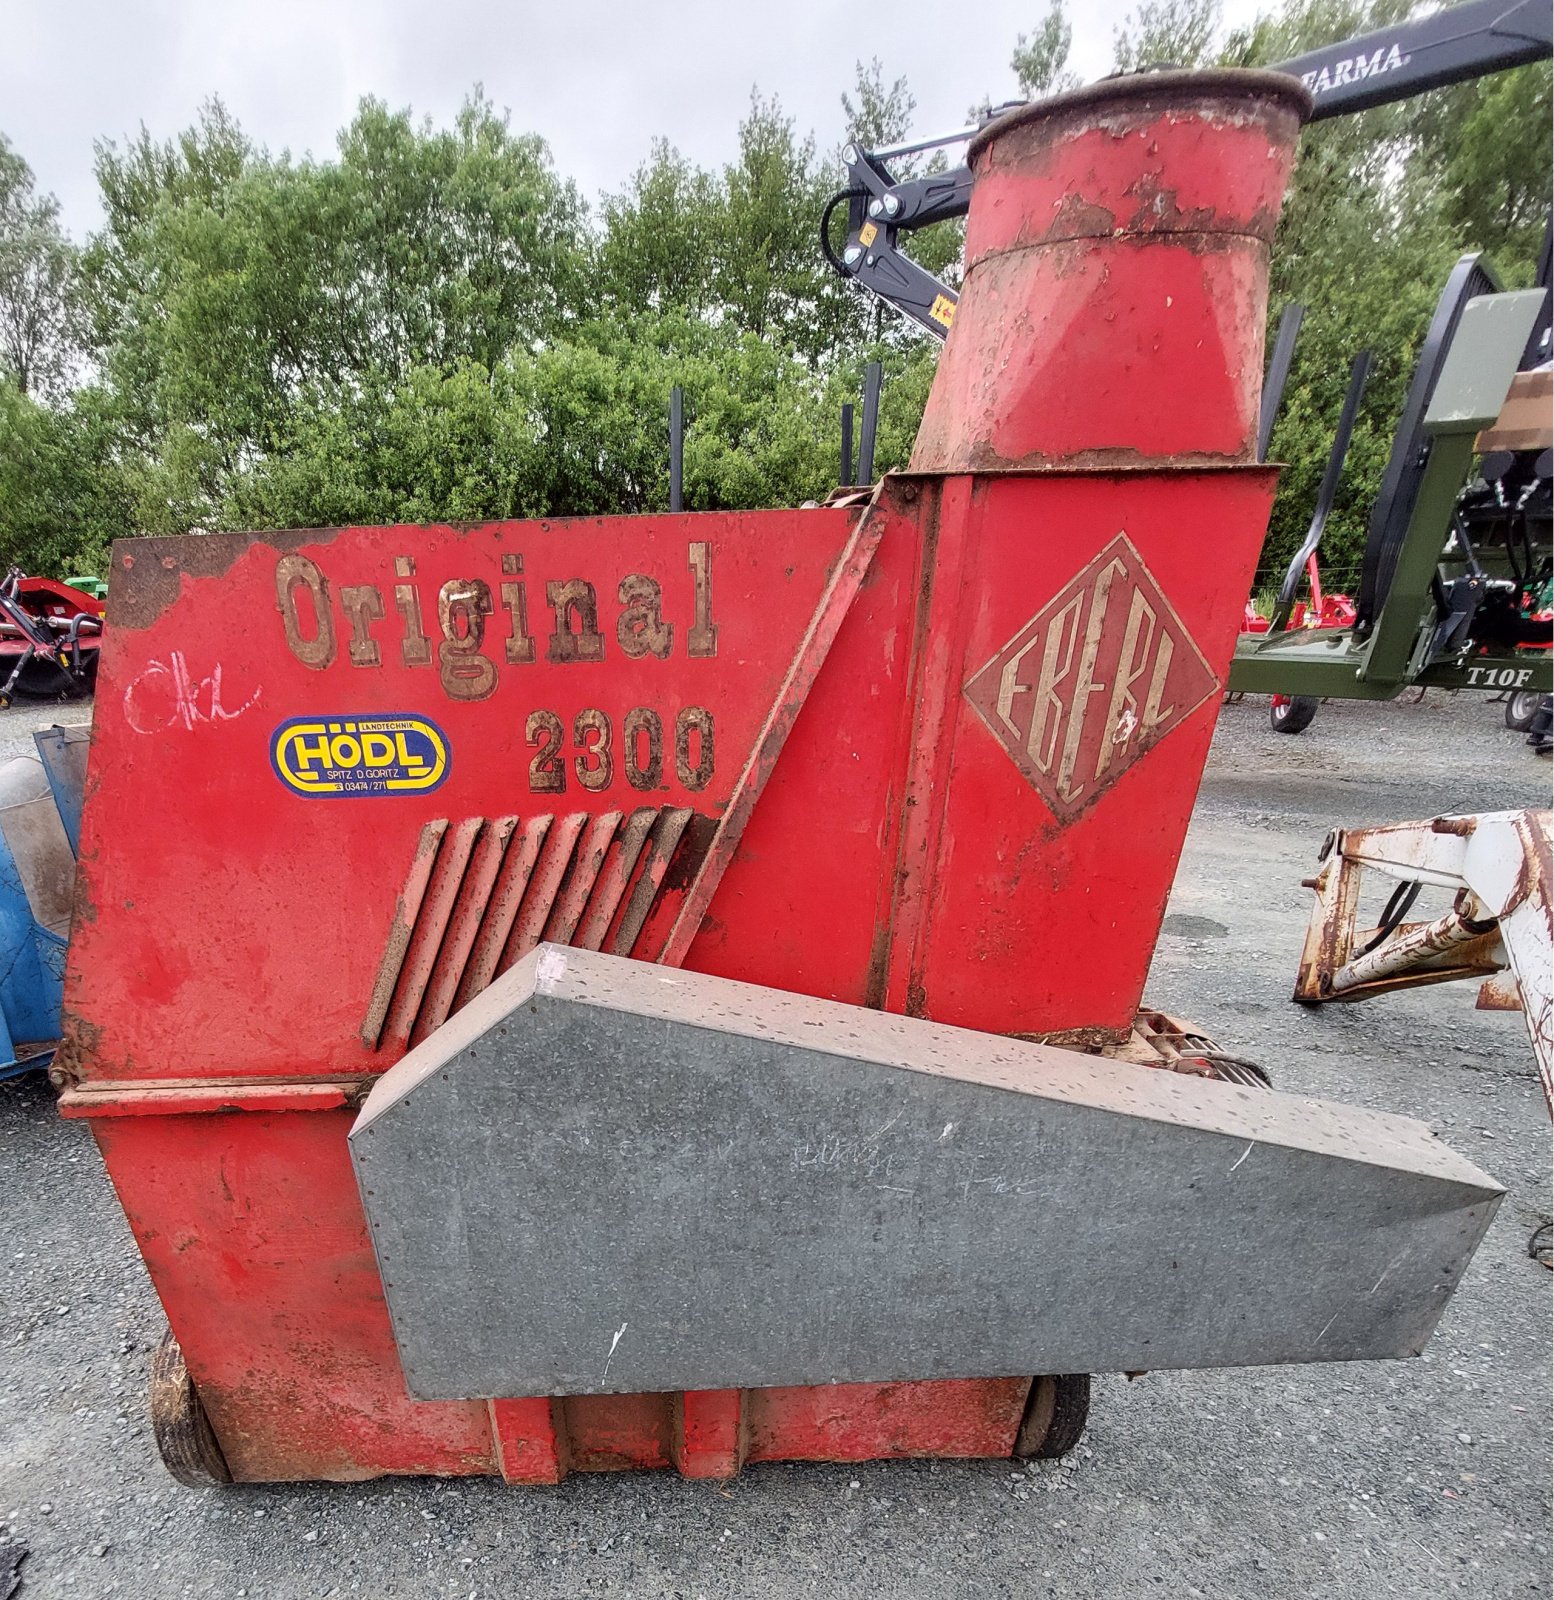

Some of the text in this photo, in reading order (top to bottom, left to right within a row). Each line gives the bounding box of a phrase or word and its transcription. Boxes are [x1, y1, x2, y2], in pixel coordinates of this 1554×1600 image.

[275, 541, 718, 701] Original
[996, 556, 1175, 804] EBERL
[1467, 667, 1533, 687] T10F
[294, 723, 424, 769] HÖDL
[361, 722, 414, 731] LANDTECHNIK
[525, 706, 716, 794] 2300
[327, 770, 353, 780] SPITZ
